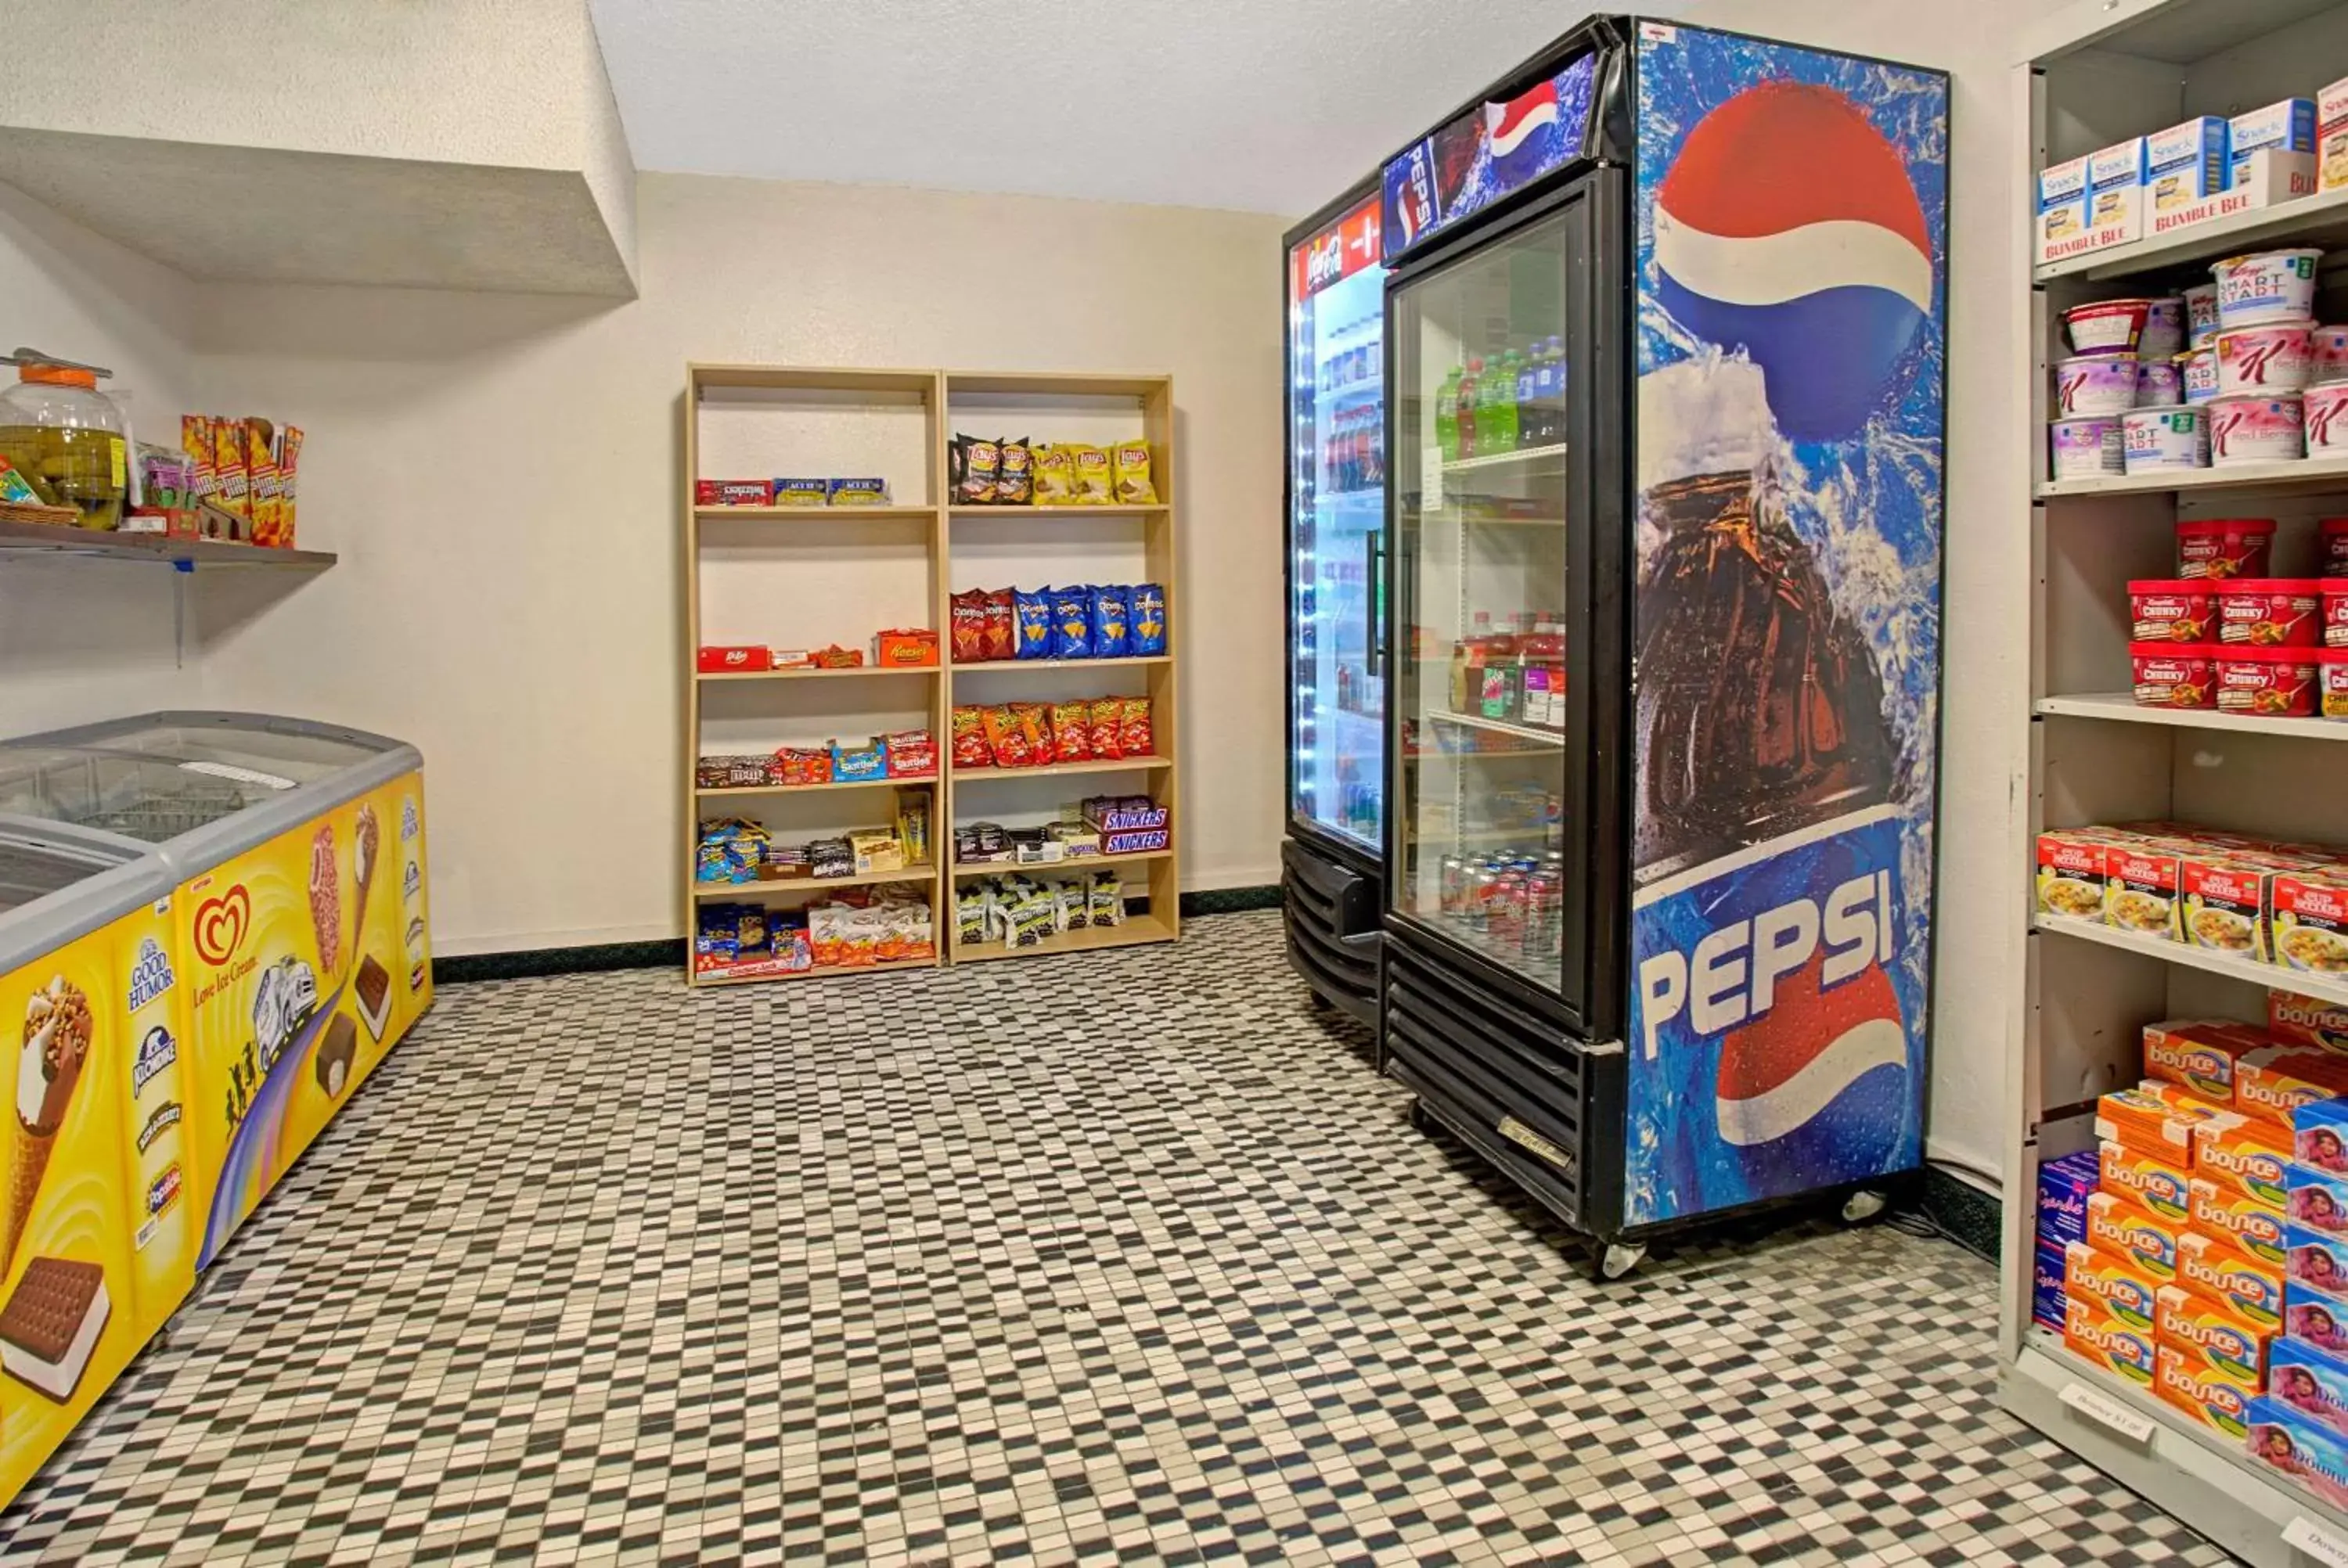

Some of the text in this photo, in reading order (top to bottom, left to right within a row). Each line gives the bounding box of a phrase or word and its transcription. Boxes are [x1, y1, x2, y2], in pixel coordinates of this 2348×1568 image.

[1409, 144, 1431, 232] PEPSI
[2155, 194, 2250, 232] BUMBLE BEE
[2045, 227, 2126, 259] BUMBLE BEE
[2220, 274, 2285, 293] SMART
[2220, 285, 2286, 304] START
[2238, 339, 2287, 384] K
[2061, 372, 2087, 412] K
[2213, 412, 2242, 457] K
[2310, 398, 2348, 446] K
[2142, 606, 2184, 619] CHUNKY
[2224, 606, 2264, 620] CHUNKY
[2144, 669, 2185, 683] CHUNKY
[2224, 672, 2269, 688] CHUNKY
[1107, 809, 1165, 829] SNICKERS
[1107, 831, 1165, 852] SNICKERS
[132, 952, 167, 987] GOOD
[193, 955, 258, 1009] Love Ice Cream
[1640, 869, 1893, 1061] PEPSI
[129, 968, 174, 1011] HUMOR
[2149, 1045, 2214, 1072] bounce
[2106, 1161, 2171, 1194] bounce
[2201, 1142, 2278, 1176] bounce
[2094, 1216, 2159, 1253] bounce
[2196, 1199, 2275, 1235] bounce
[2073, 1264, 2137, 1304] bounce
[2184, 1257, 2259, 1296] bounce
[2073, 1317, 2137, 1357] bounce
[2164, 1310, 2239, 1352] bounce
[2165, 1365, 2238, 1410] bounce
